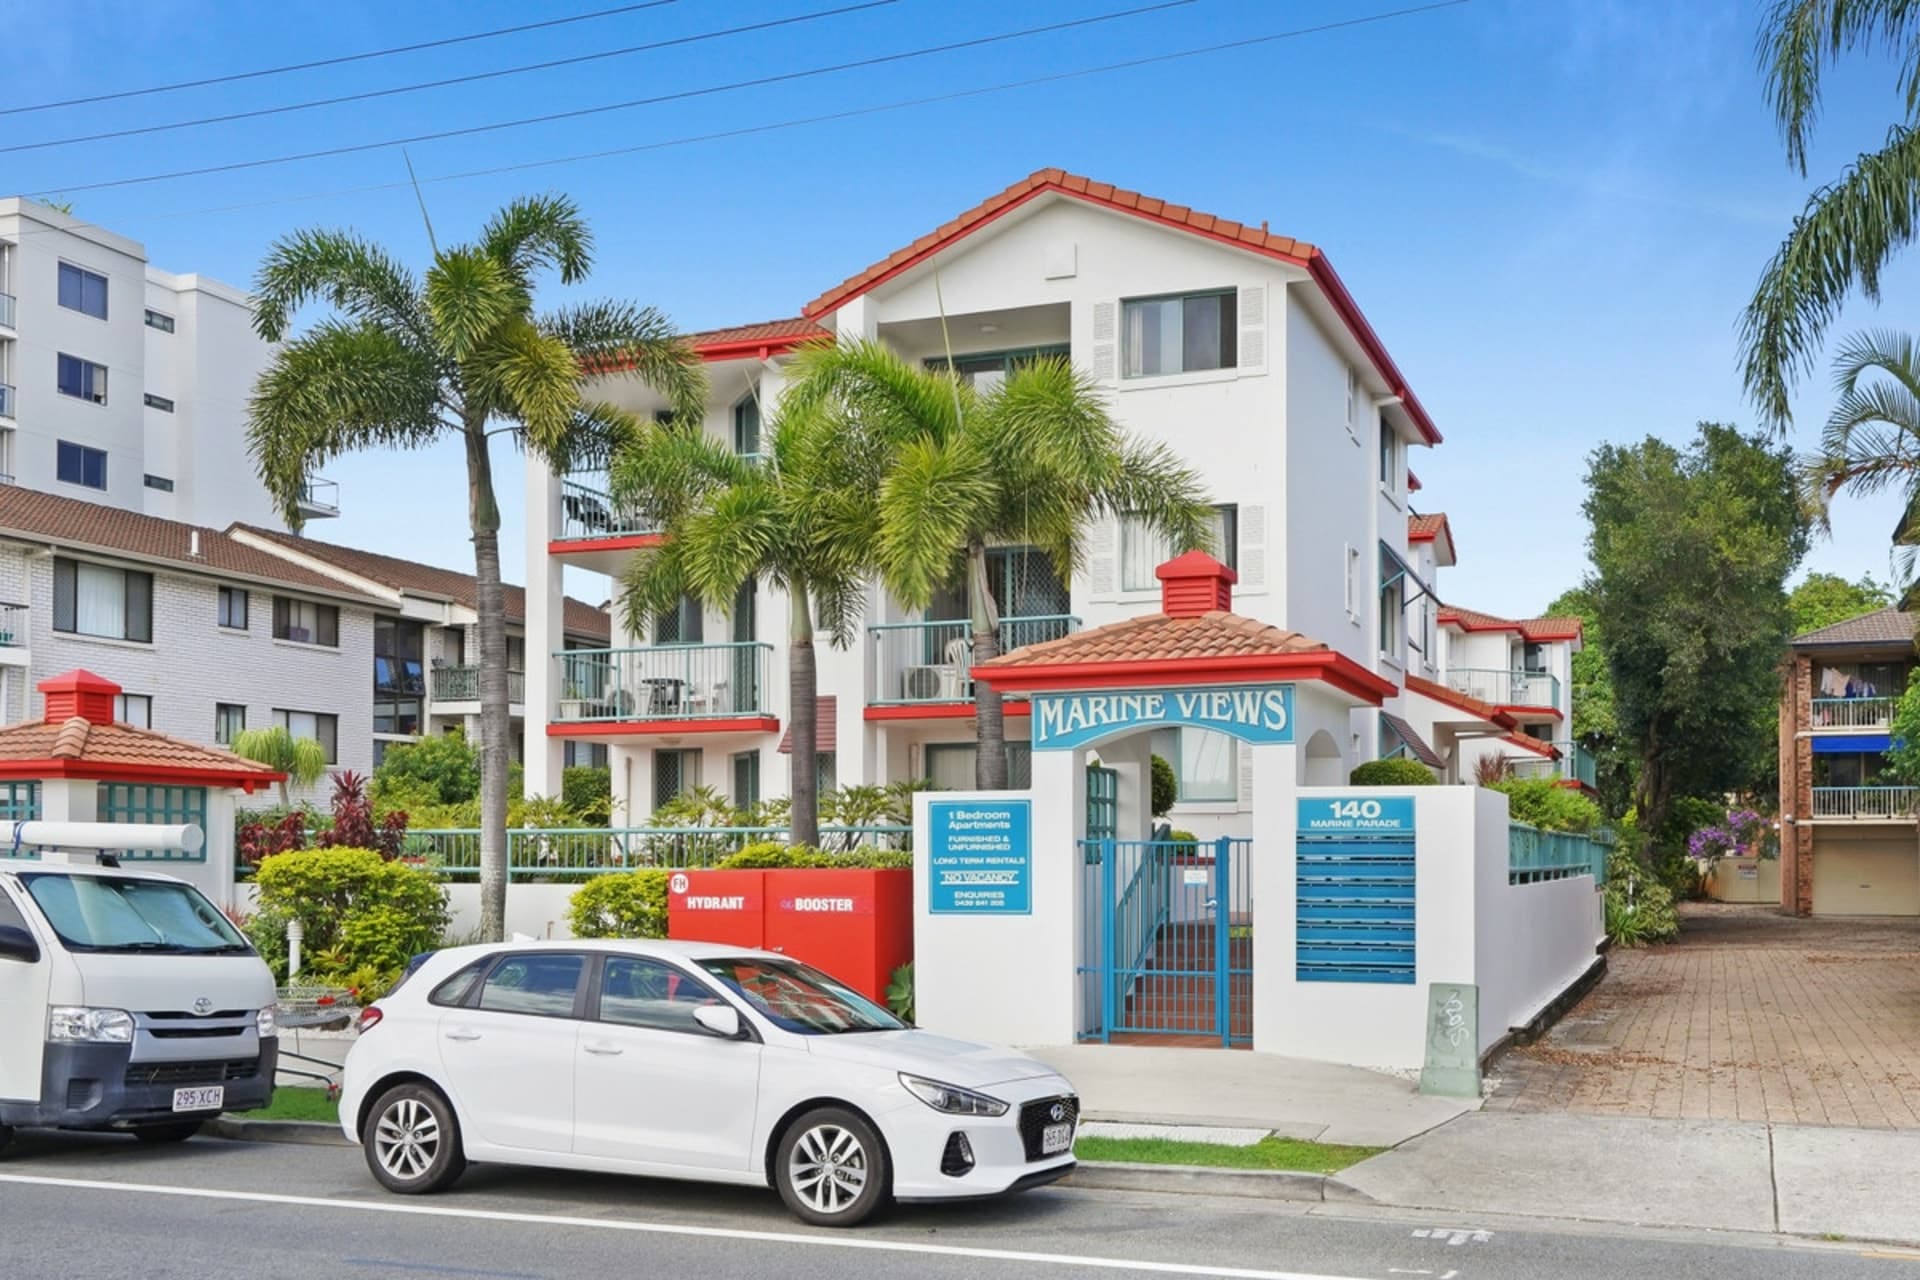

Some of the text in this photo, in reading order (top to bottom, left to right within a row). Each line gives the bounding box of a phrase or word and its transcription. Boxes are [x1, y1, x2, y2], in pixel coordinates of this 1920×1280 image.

[1038, 689, 1288, 742] MARINE VIEWS
[1329, 800, 1382, 819] 140
[948, 811, 1011, 820] 1 Bedroom
[948, 821, 1011, 831] Apartments
[1310, 819, 1401, 828] MARINE PARADE
[948, 835, 1001, 843] FURNISHED
[948, 843, 1011, 851] UNFURNISHED
[933, 857, 1026, 865] LONG TERM RENTALS
[944, 873, 1015, 882] NO VACANCY
[673, 877, 686, 889] FH
[687, 896, 745, 910] HYDRANT
[795, 897, 854, 912] BOOSTER
